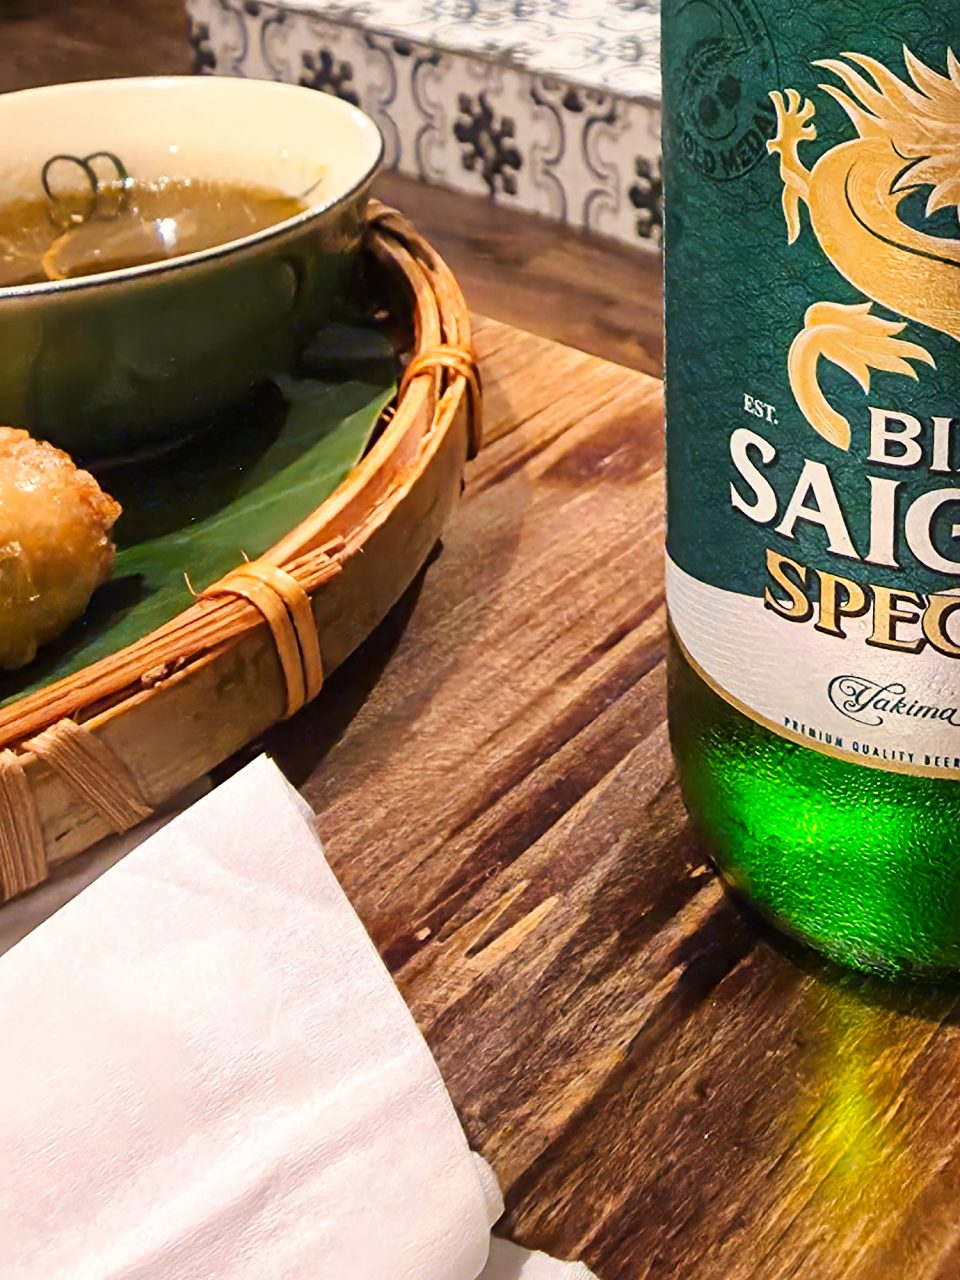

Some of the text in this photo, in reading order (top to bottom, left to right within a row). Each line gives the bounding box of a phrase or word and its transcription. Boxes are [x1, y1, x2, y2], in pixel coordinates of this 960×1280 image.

[743, 394, 779, 424] EST.
[827, 674, 957, 727] Yakima
[783, 716, 843, 748] PREMIUM
[851, 741, 914, 764] QUALITY
[924, 753, 960, 770] BEER
